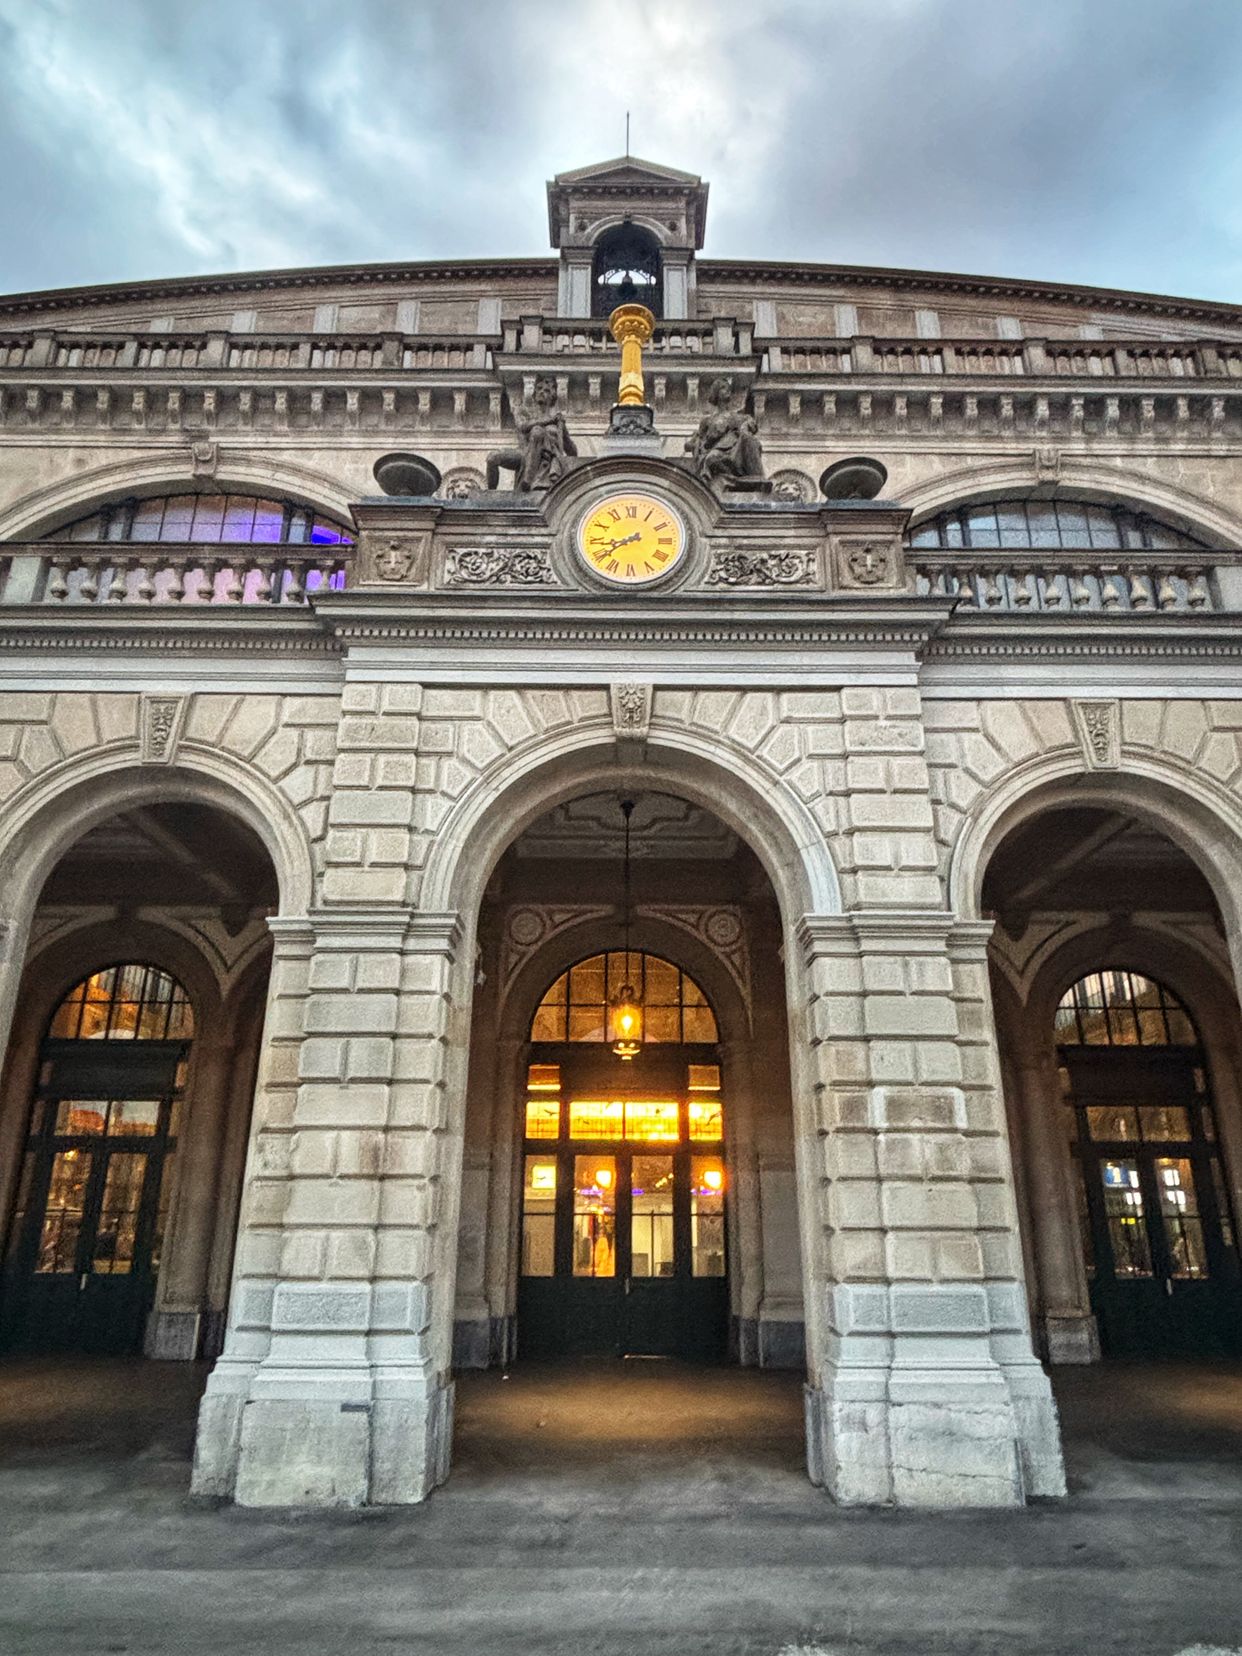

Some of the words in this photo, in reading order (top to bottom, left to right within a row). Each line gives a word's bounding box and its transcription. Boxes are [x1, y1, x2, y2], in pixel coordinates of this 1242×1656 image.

[608, 508, 621, 523] XI
[625, 506, 637, 519] XII
[644, 509, 653, 522] I
[594, 519, 610, 532] X
[653, 521, 668, 532] II
[589, 536, 605, 545] IX
[605, 558, 619, 574] VII
[626, 563, 636, 577] VI
[644, 561, 655, 574] V
